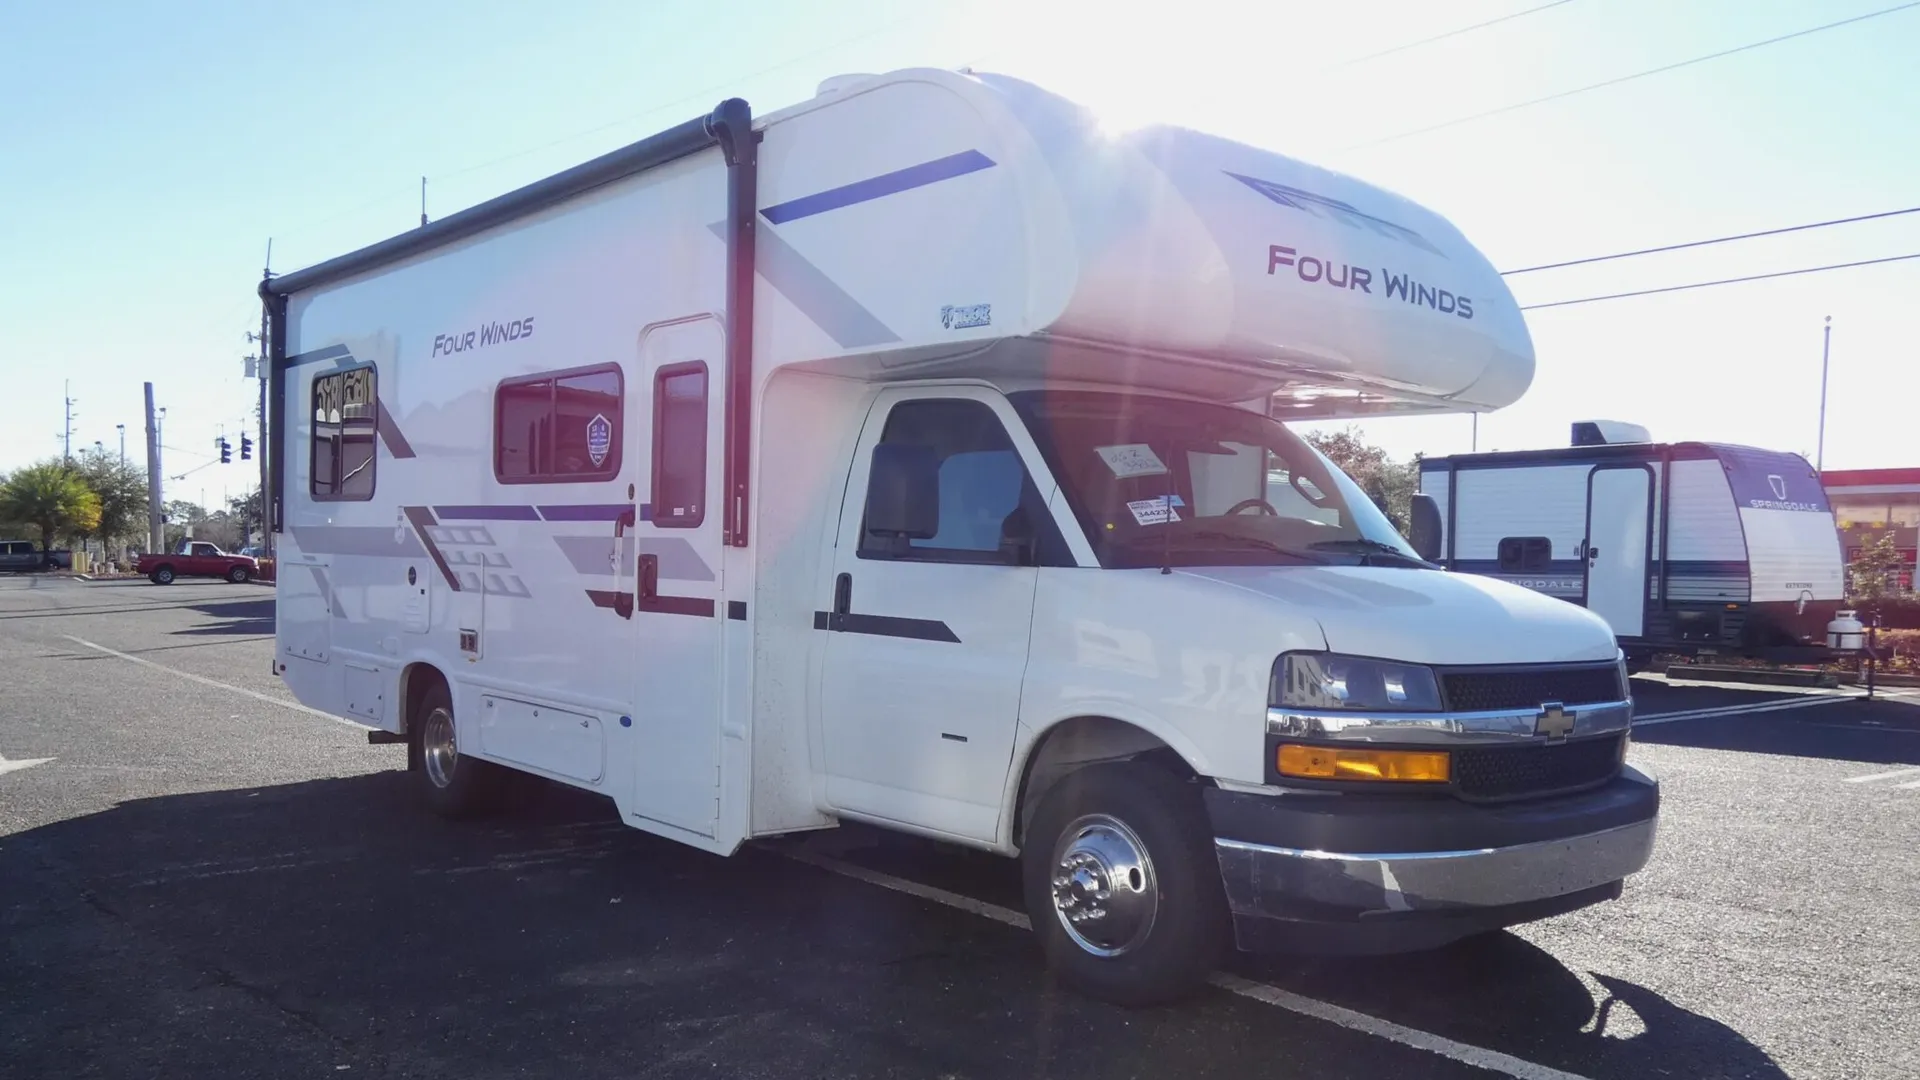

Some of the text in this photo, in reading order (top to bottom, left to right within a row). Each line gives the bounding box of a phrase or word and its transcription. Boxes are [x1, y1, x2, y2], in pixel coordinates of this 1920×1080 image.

[1267, 244, 1474, 320] FOUR WINDS
[432, 316, 535, 358] FOUR WINDS
[1750, 499, 1820, 512] SPRINGDALE
[1510, 580, 1583, 589] NGDALE
